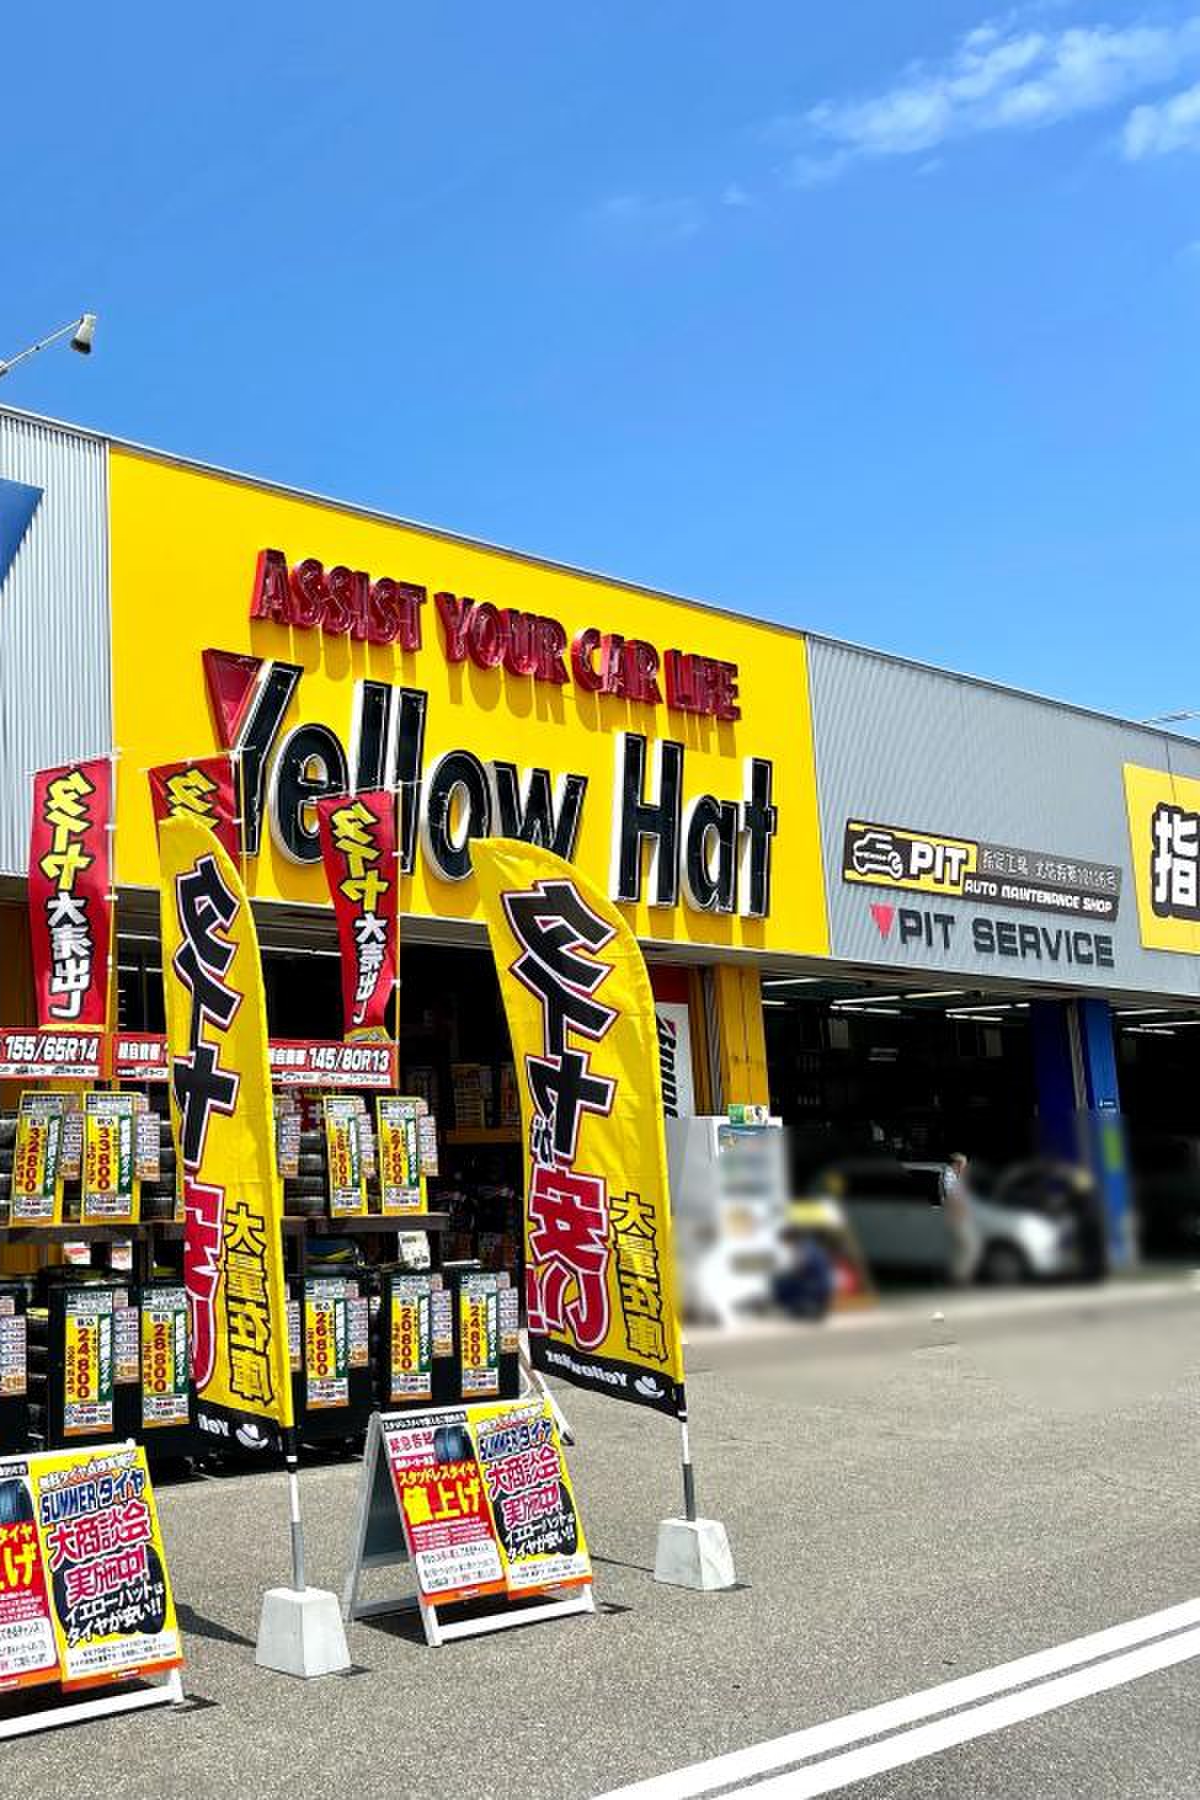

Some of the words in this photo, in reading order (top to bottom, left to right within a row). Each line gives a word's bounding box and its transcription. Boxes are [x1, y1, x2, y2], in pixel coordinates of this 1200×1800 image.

[251, 548, 426, 651] ASSIST
[435, 591, 569, 685] YOUR
[572, 627, 662, 703] CAR
[665, 648, 743, 722] LIFE
[202, 648, 587, 881] Yellow
[608, 731, 778, 918] Hat
[910, 842, 967, 880] PIT
[1153, 808, 1199, 909] 指
[965, 880, 997, 896] AUTO
[1084, 897, 1112, 912] SHOP
[898, 908, 955, 949] PIT
[972, 917, 1115, 967] SERVICE
[6, 1035, 99, 1062] 155/65R14
[309, 1047, 390, 1073] 145/80R13
[48, 1499, 152, 1572] 大商談会
